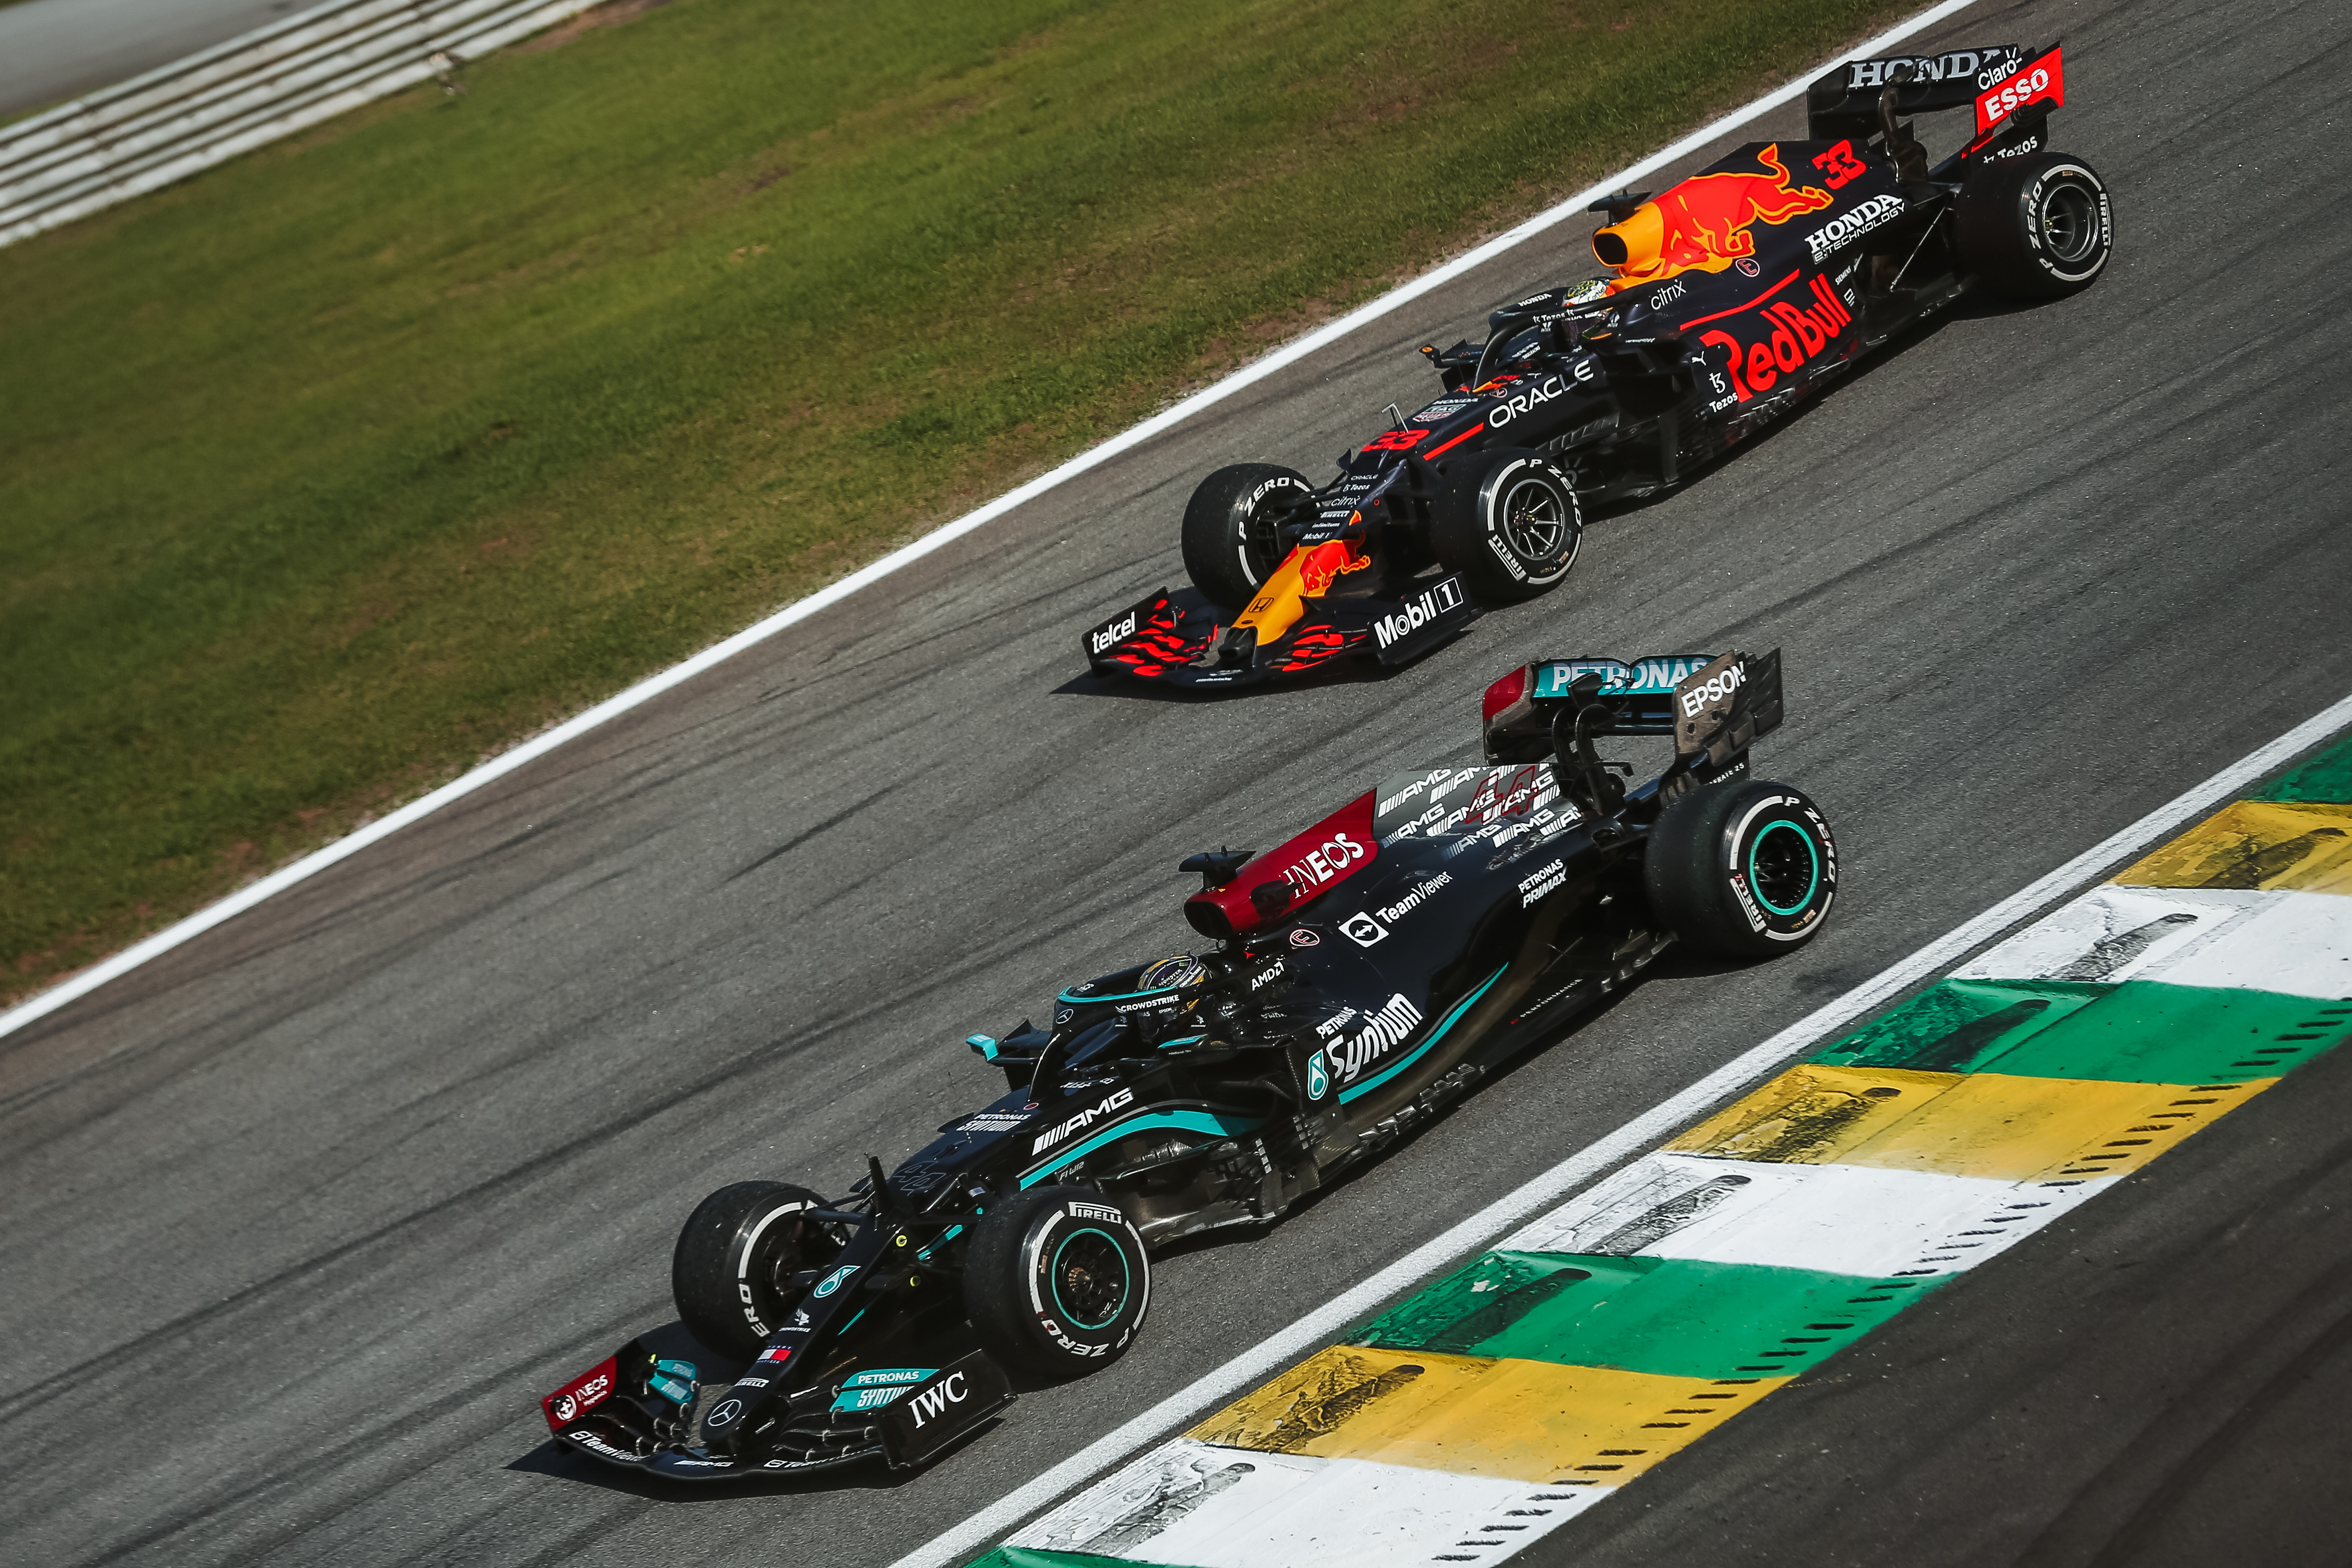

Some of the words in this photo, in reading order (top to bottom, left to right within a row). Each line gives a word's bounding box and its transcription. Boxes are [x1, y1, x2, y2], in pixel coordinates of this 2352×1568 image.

[1978, 54, 2019, 90] Claro
[1985, 68, 2049, 122] ESSO
[1812, 139, 1866, 190] 33
[1804, 194, 1903, 253] HONDA
[2027, 181, 2042, 249] ZERO
[1518, 293, 1552, 307] HONDA
[1650, 279, 1686, 310] citrix
[1489, 359, 1594, 428] ORACLE
[1709, 392, 1738, 413] Tezos
[1244, 477, 1290, 517] ZERO
[1331, 495, 1361, 508] citrix
[1548, 464, 1582, 527] ZERO
[1488, 534, 1526, 581] PIRELLI
[1091, 611, 1136, 654] telcel
[1374, 591, 1437, 649] Mobil
[1681, 661, 1747, 718] EPSON
[1282, 832, 1364, 899] INEOS
[1804, 808, 1836, 883] ZERO
[1375, 870, 1453, 924] TeamViewer
[1518, 858, 1564, 893] PETRONAS
[1523, 866, 1568, 909] PRIMAX
[1251, 966, 1277, 991] AMD
[1120, 994, 1180, 1012] CROWDSTRIKE
[1316, 1006, 1357, 1040] PETRONAS
[1326, 993, 1424, 1083] Syntium
[1068, 1201, 1122, 1224] PIRELLI
[1040, 1319, 1109, 1357] ZERO
[575, 1375, 608, 1401] INEOS
[858, 1371, 919, 1385] PETRONAS
[908, 1371, 968, 1429] IWC
